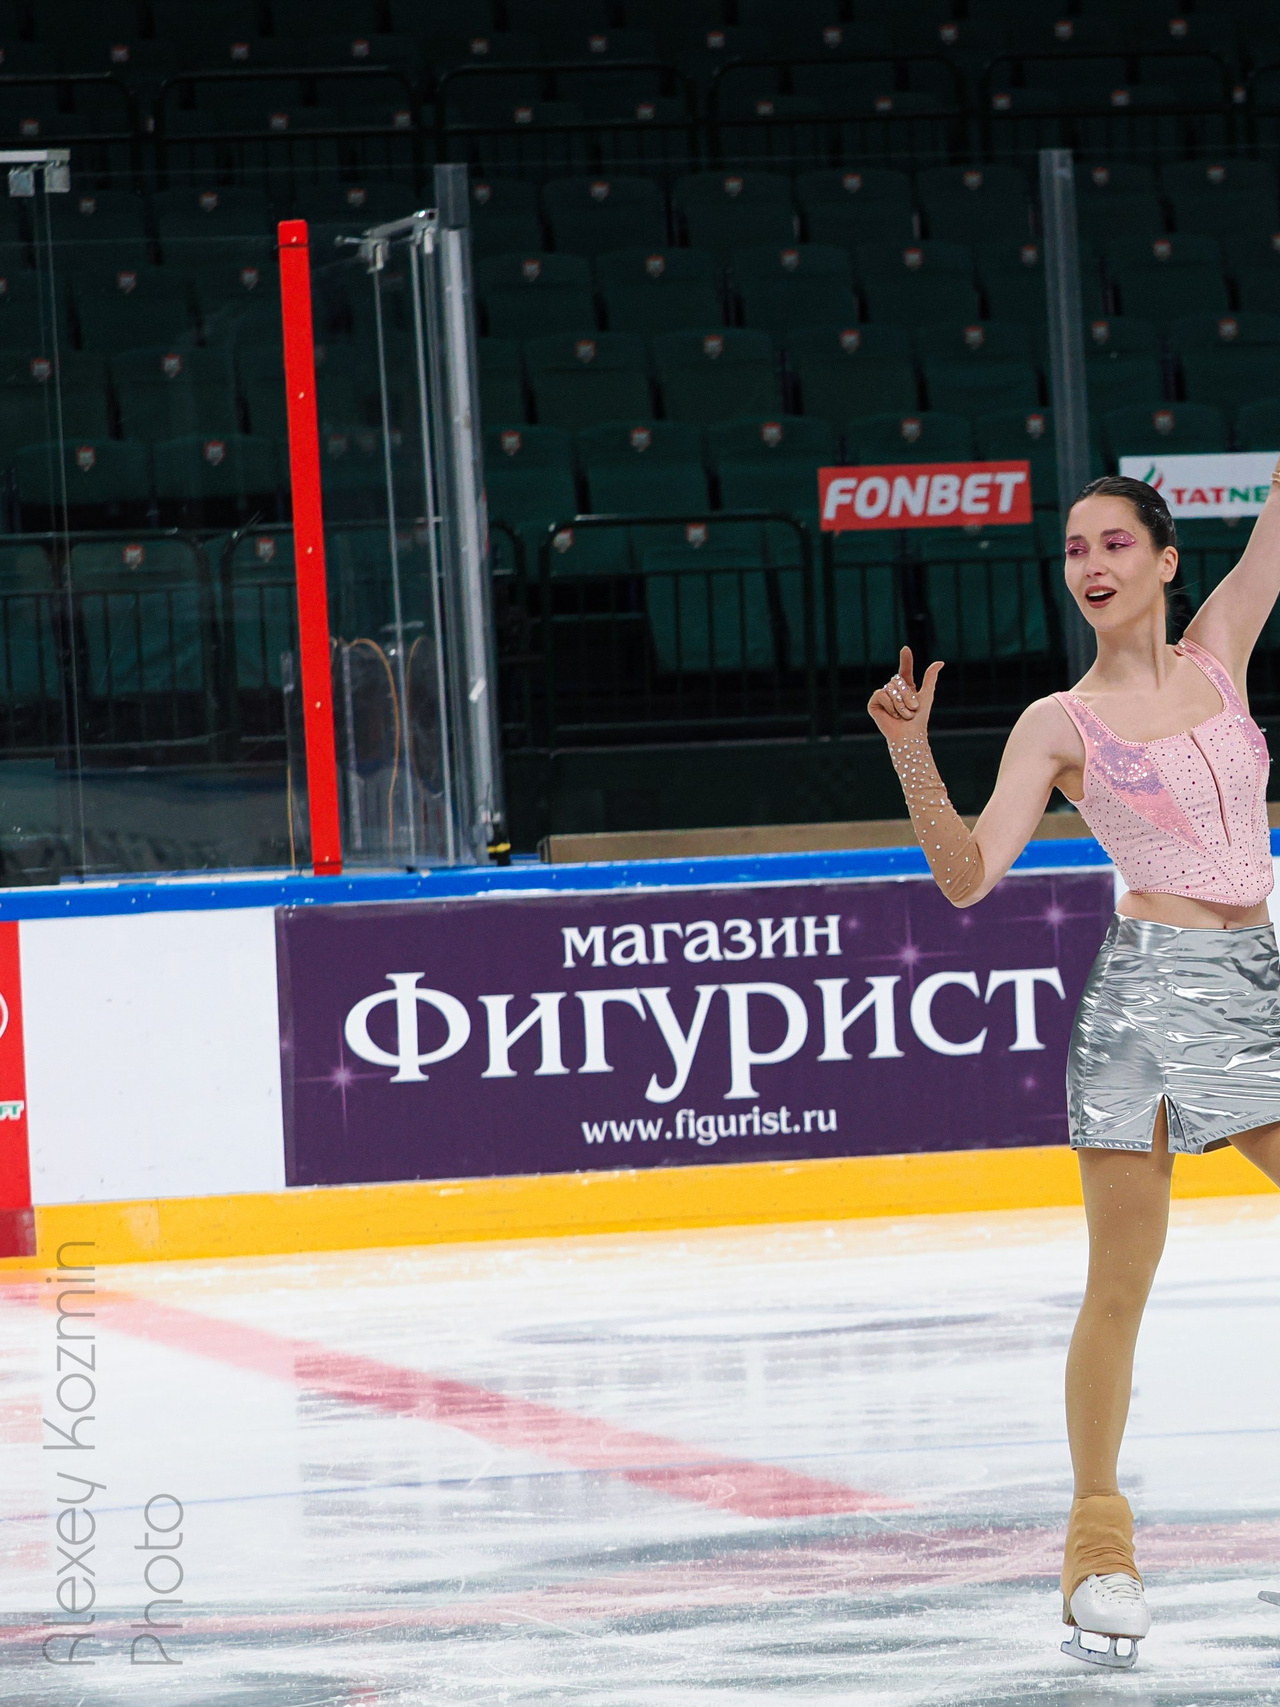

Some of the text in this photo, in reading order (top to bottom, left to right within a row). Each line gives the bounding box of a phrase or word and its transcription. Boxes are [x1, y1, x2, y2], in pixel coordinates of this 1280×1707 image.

[823, 471, 1026, 521] FONBET
[1171, 485, 1270, 506] TATNE
[561, 914, 843, 967] магазин
[343, 967, 1066, 1104] Фигурист
[582, 1105, 839, 1146] www.figurist.ru
